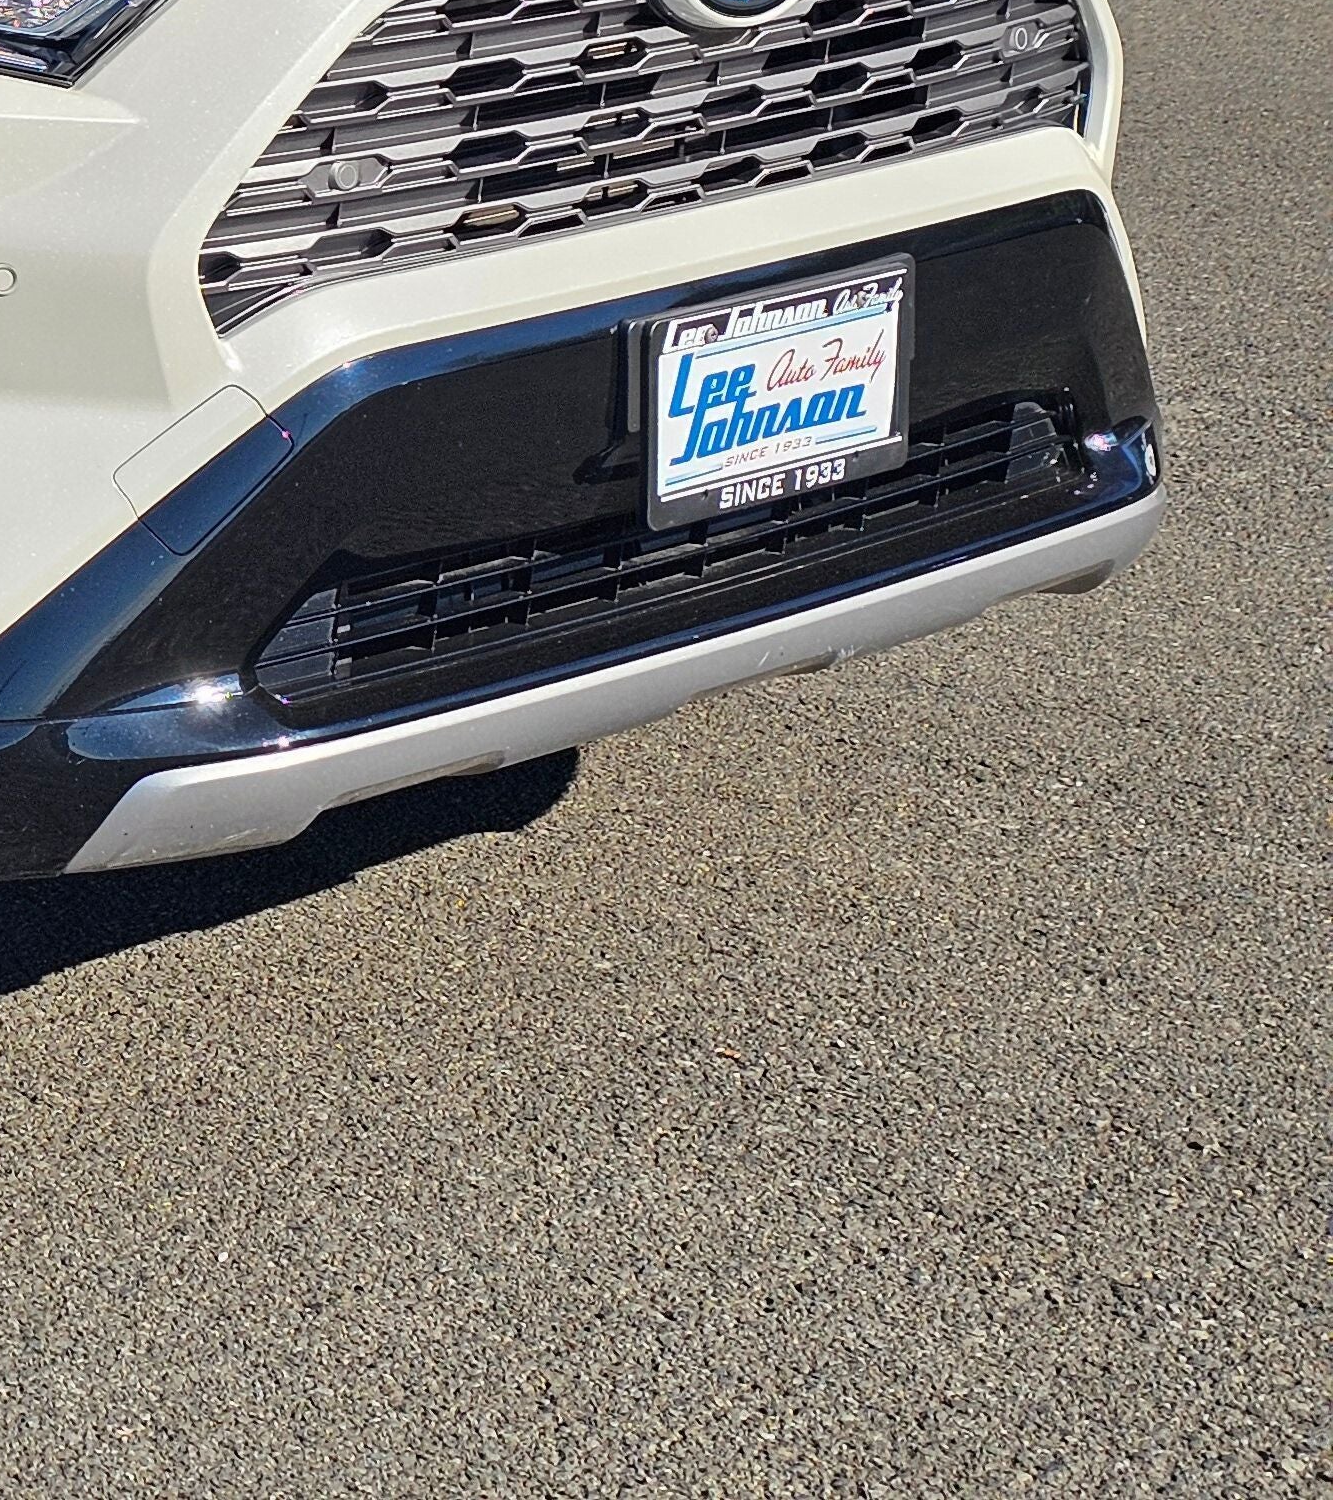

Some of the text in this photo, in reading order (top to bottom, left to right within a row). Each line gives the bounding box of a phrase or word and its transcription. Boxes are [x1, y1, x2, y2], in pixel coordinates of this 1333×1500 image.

[717, 297, 830, 341] Johnson
[668, 352, 757, 419] Lee
[766, 328, 887, 392] Auto Family
[669, 384, 867, 467] Johnson
[724, 435, 813, 468] SINCE 1933
[719, 457, 846, 510] SINCE 1933
